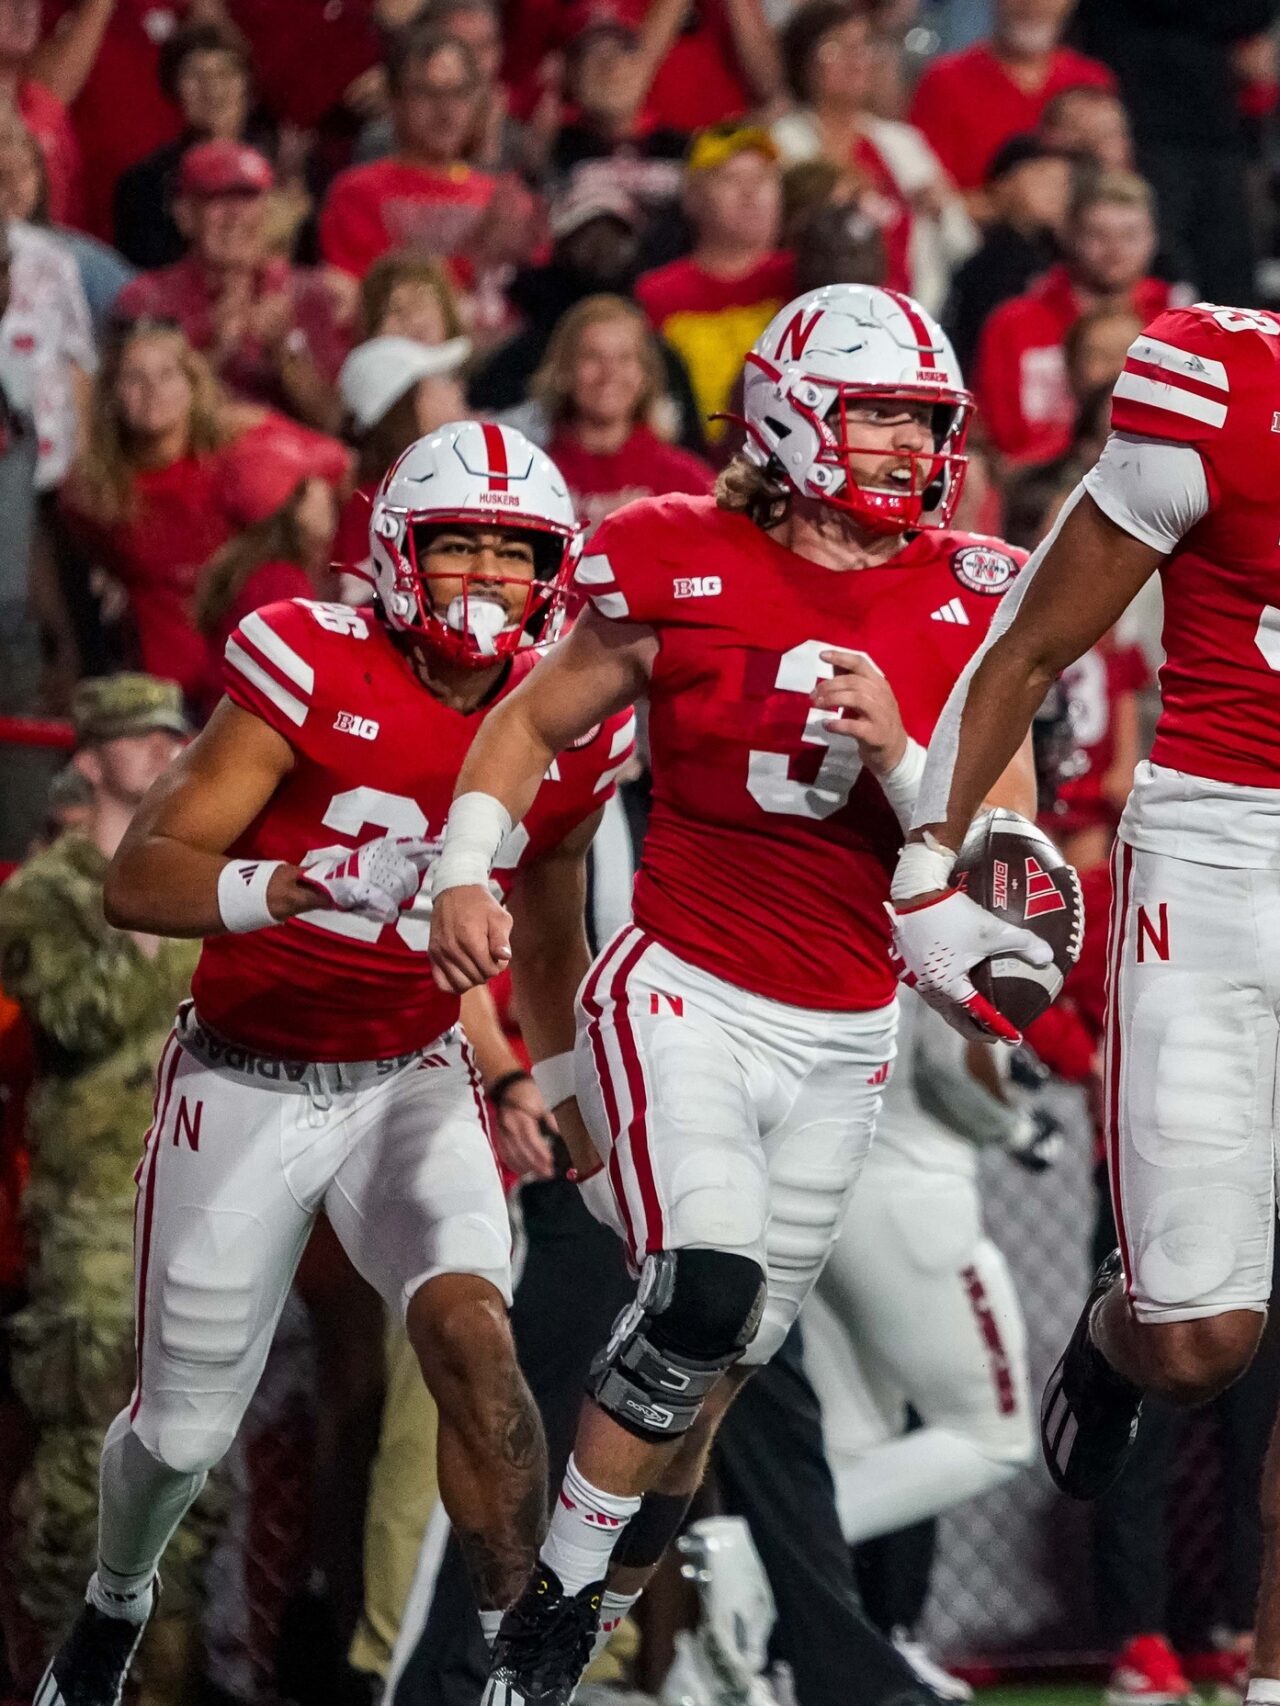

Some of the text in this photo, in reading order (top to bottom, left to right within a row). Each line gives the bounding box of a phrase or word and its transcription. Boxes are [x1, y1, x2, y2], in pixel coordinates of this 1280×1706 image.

[775, 309, 825, 361] N
[479, 492, 520, 507] HUSKERS
[746, 639, 885, 821] 3
[993, 859, 1008, 911] DIME
[1137, 903, 1170, 963] N
[173, 1096, 203, 1152] N
